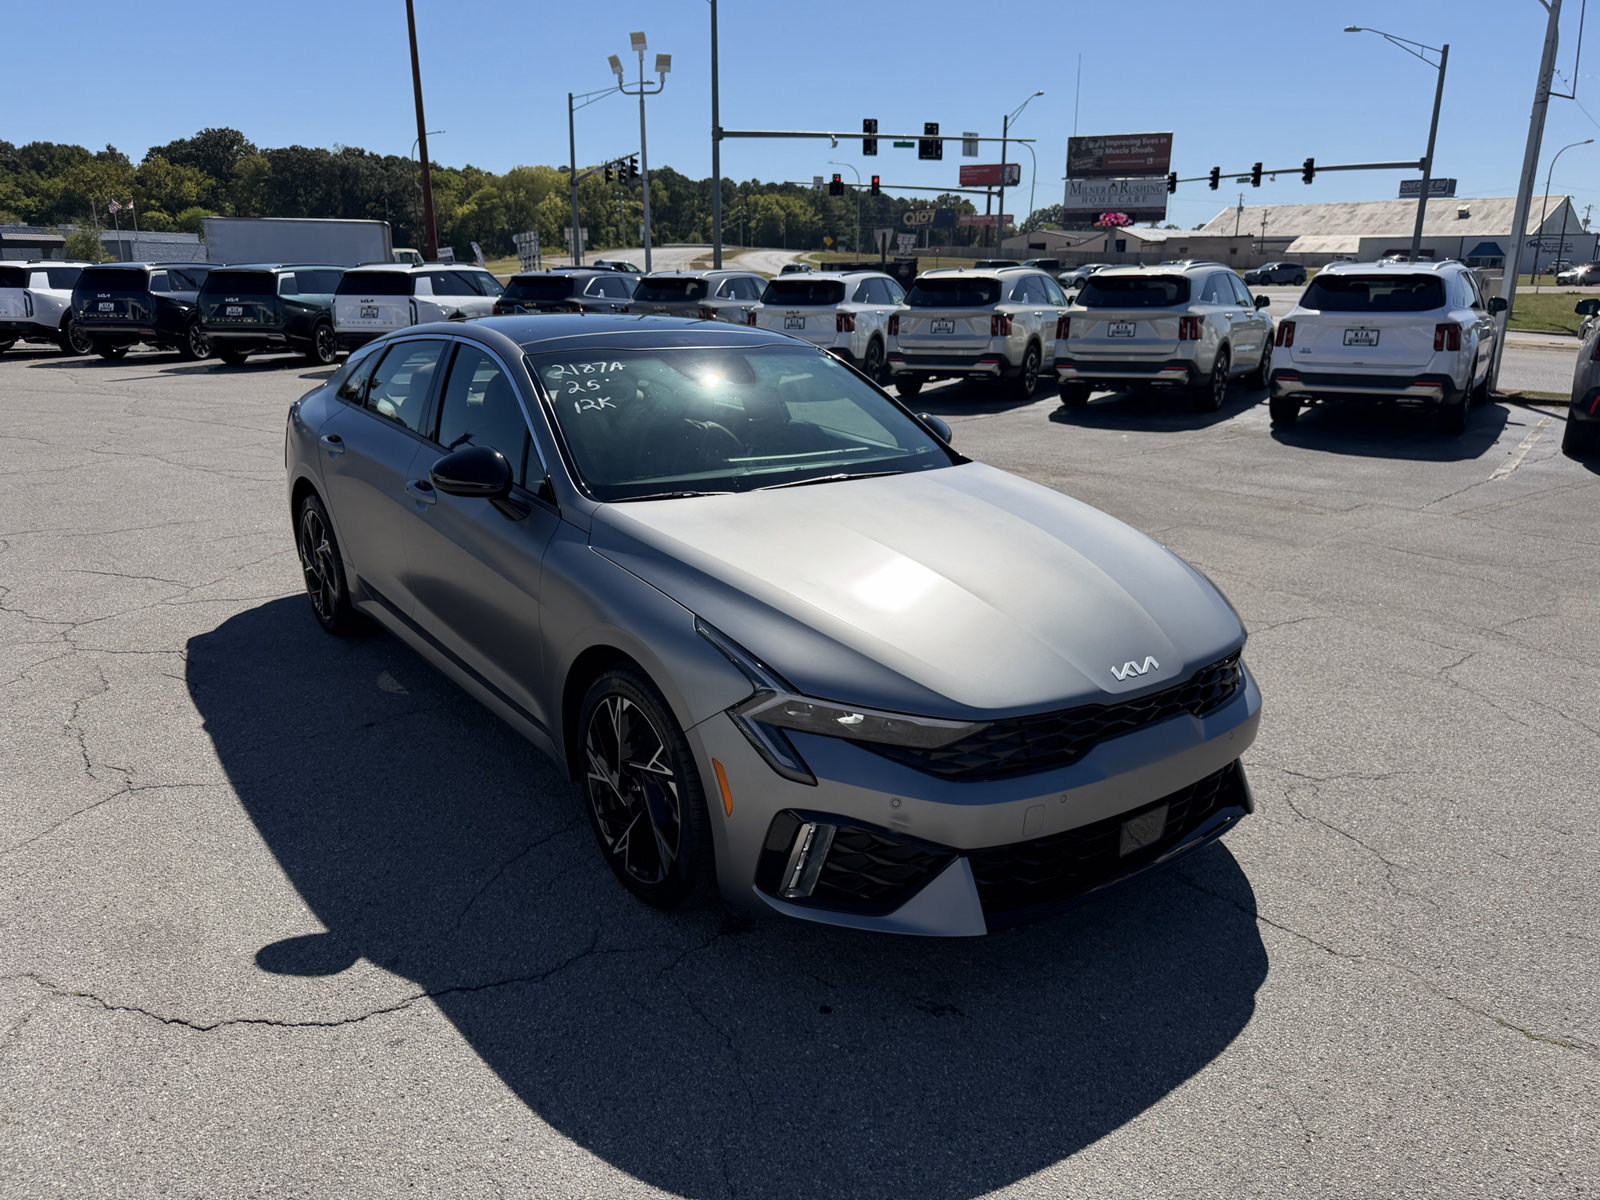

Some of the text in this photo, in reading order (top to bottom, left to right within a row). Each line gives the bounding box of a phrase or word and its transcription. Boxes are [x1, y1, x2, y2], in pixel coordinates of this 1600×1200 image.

[1105, 136, 1168, 147] Improving lives in
[1130, 146, 1155, 154] Shoals.
[1070, 181, 1163, 196] MILNER RUSHING
[1081, 195, 1147, 204] HOME CARE
[903, 209, 936, 226] Q107
[551, 361, 626, 375] 2187A
[574, 396, 616, 414] 12K
[1110, 655, 1160, 682] KIA
